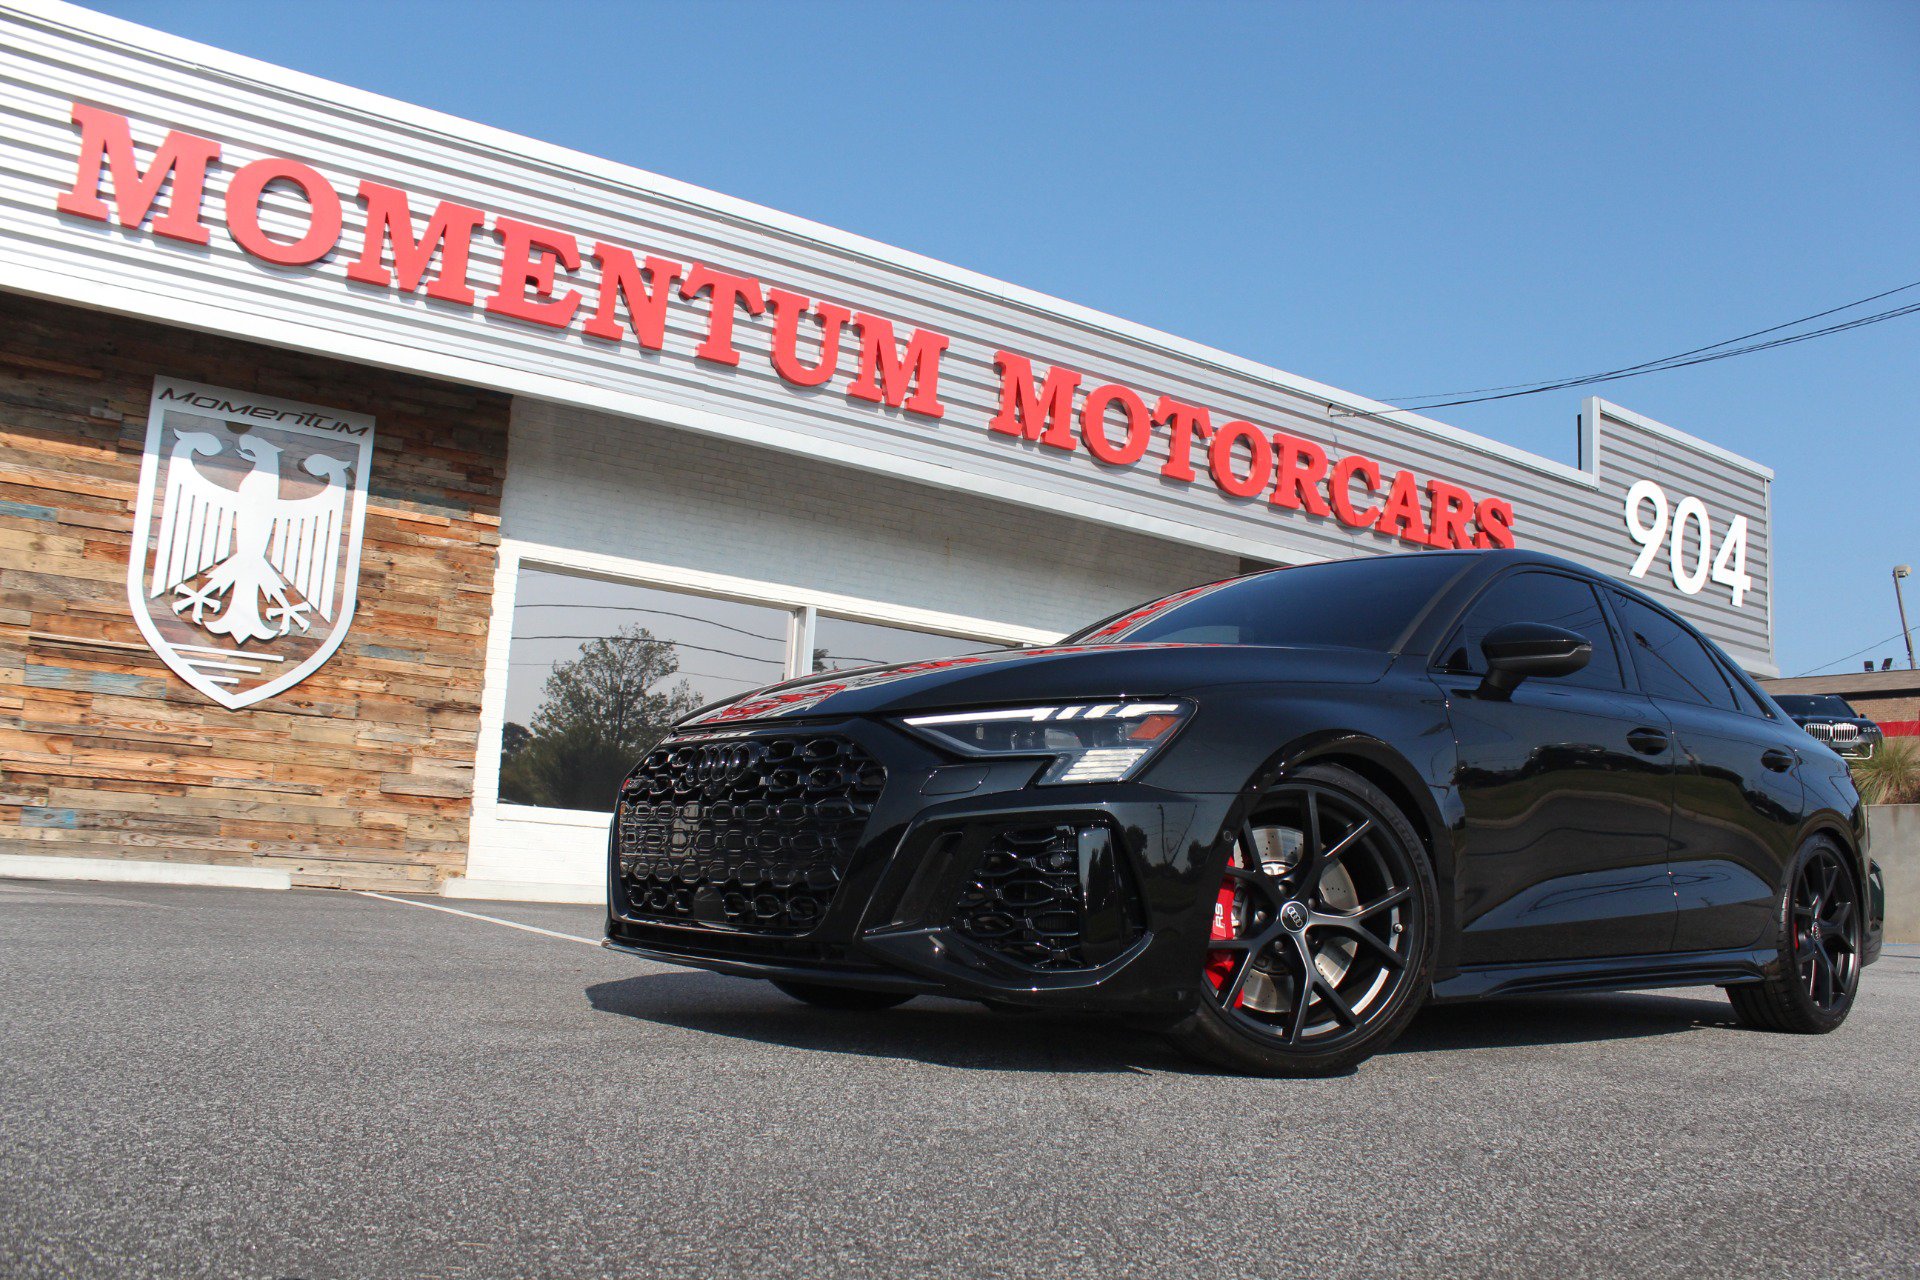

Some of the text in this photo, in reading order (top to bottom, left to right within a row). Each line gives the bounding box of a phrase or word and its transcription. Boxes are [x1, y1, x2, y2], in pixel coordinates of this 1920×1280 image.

[57, 102, 1515, 549] MOMENTUM MOTORCARS
[1625, 480, 1751, 607] 904
